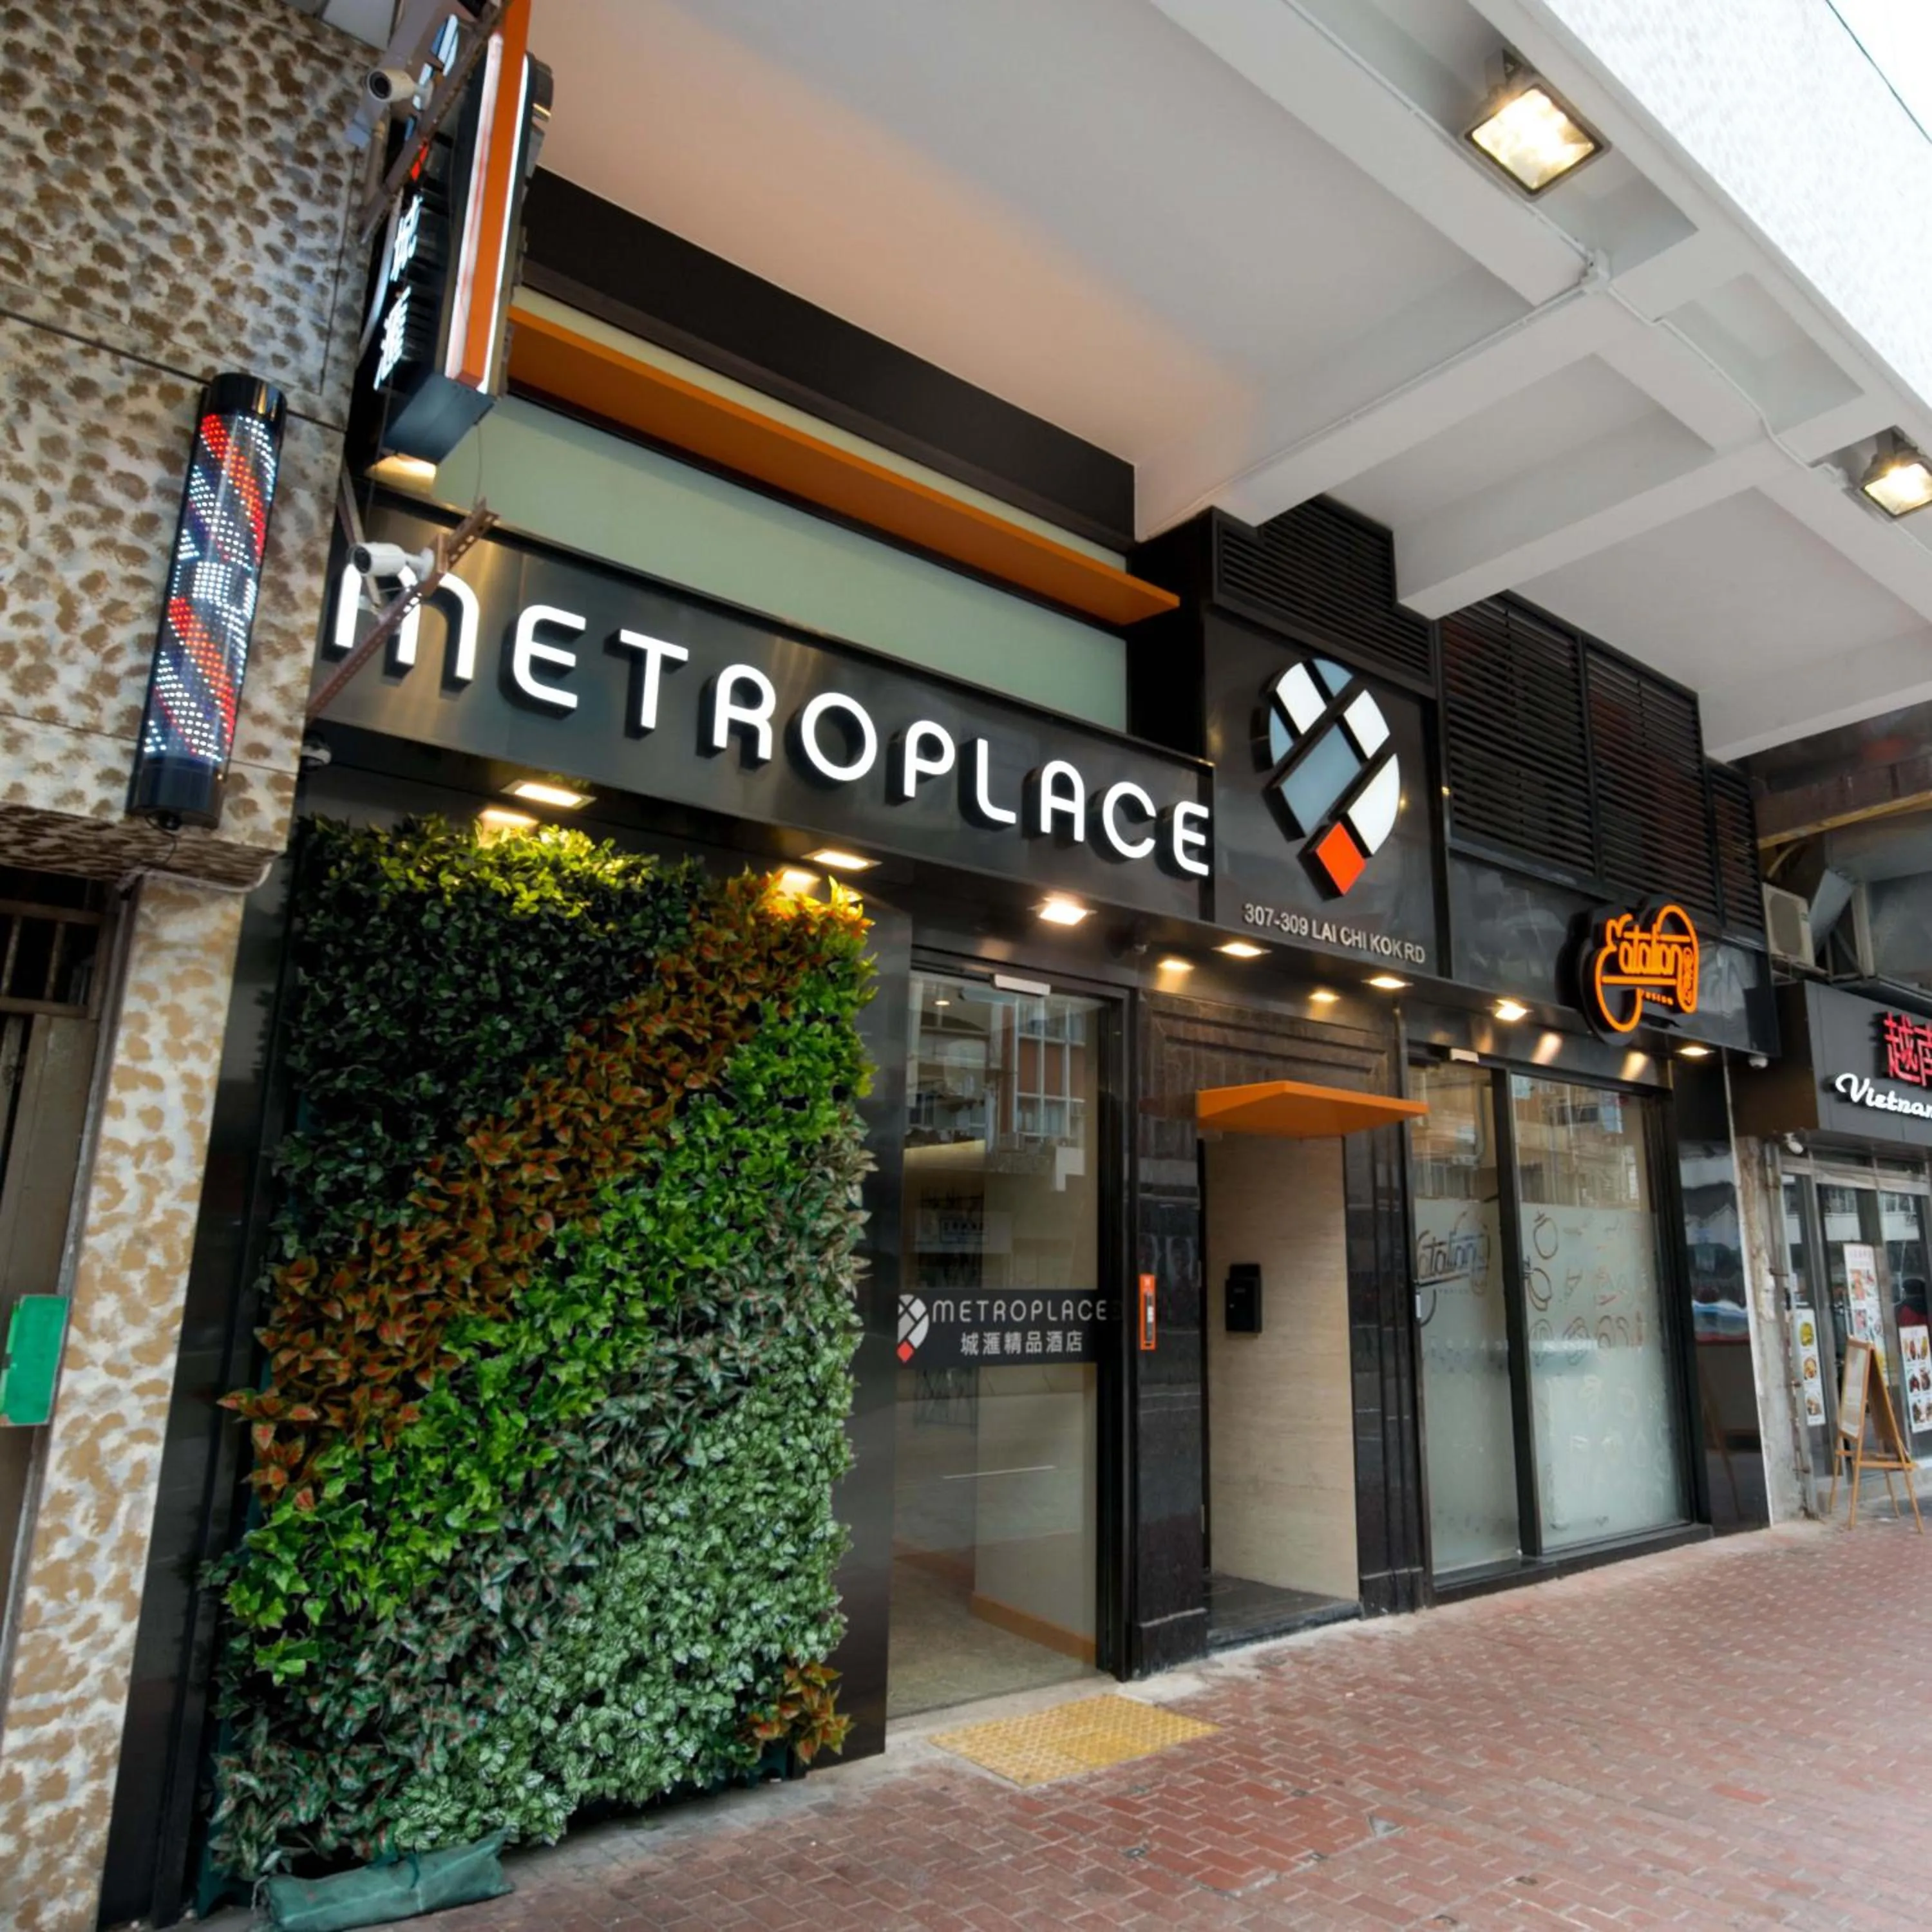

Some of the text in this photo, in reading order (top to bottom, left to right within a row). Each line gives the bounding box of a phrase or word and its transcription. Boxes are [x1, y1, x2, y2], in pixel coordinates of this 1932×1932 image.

[334, 563, 1209, 876] METROPLACE
[1244, 903, 1309, 936] 307-309
[1312, 919, 1336, 943] LAI
[1340, 926, 1367, 949] CHI
[932, 1299, 1107, 1323] METROPLACE
